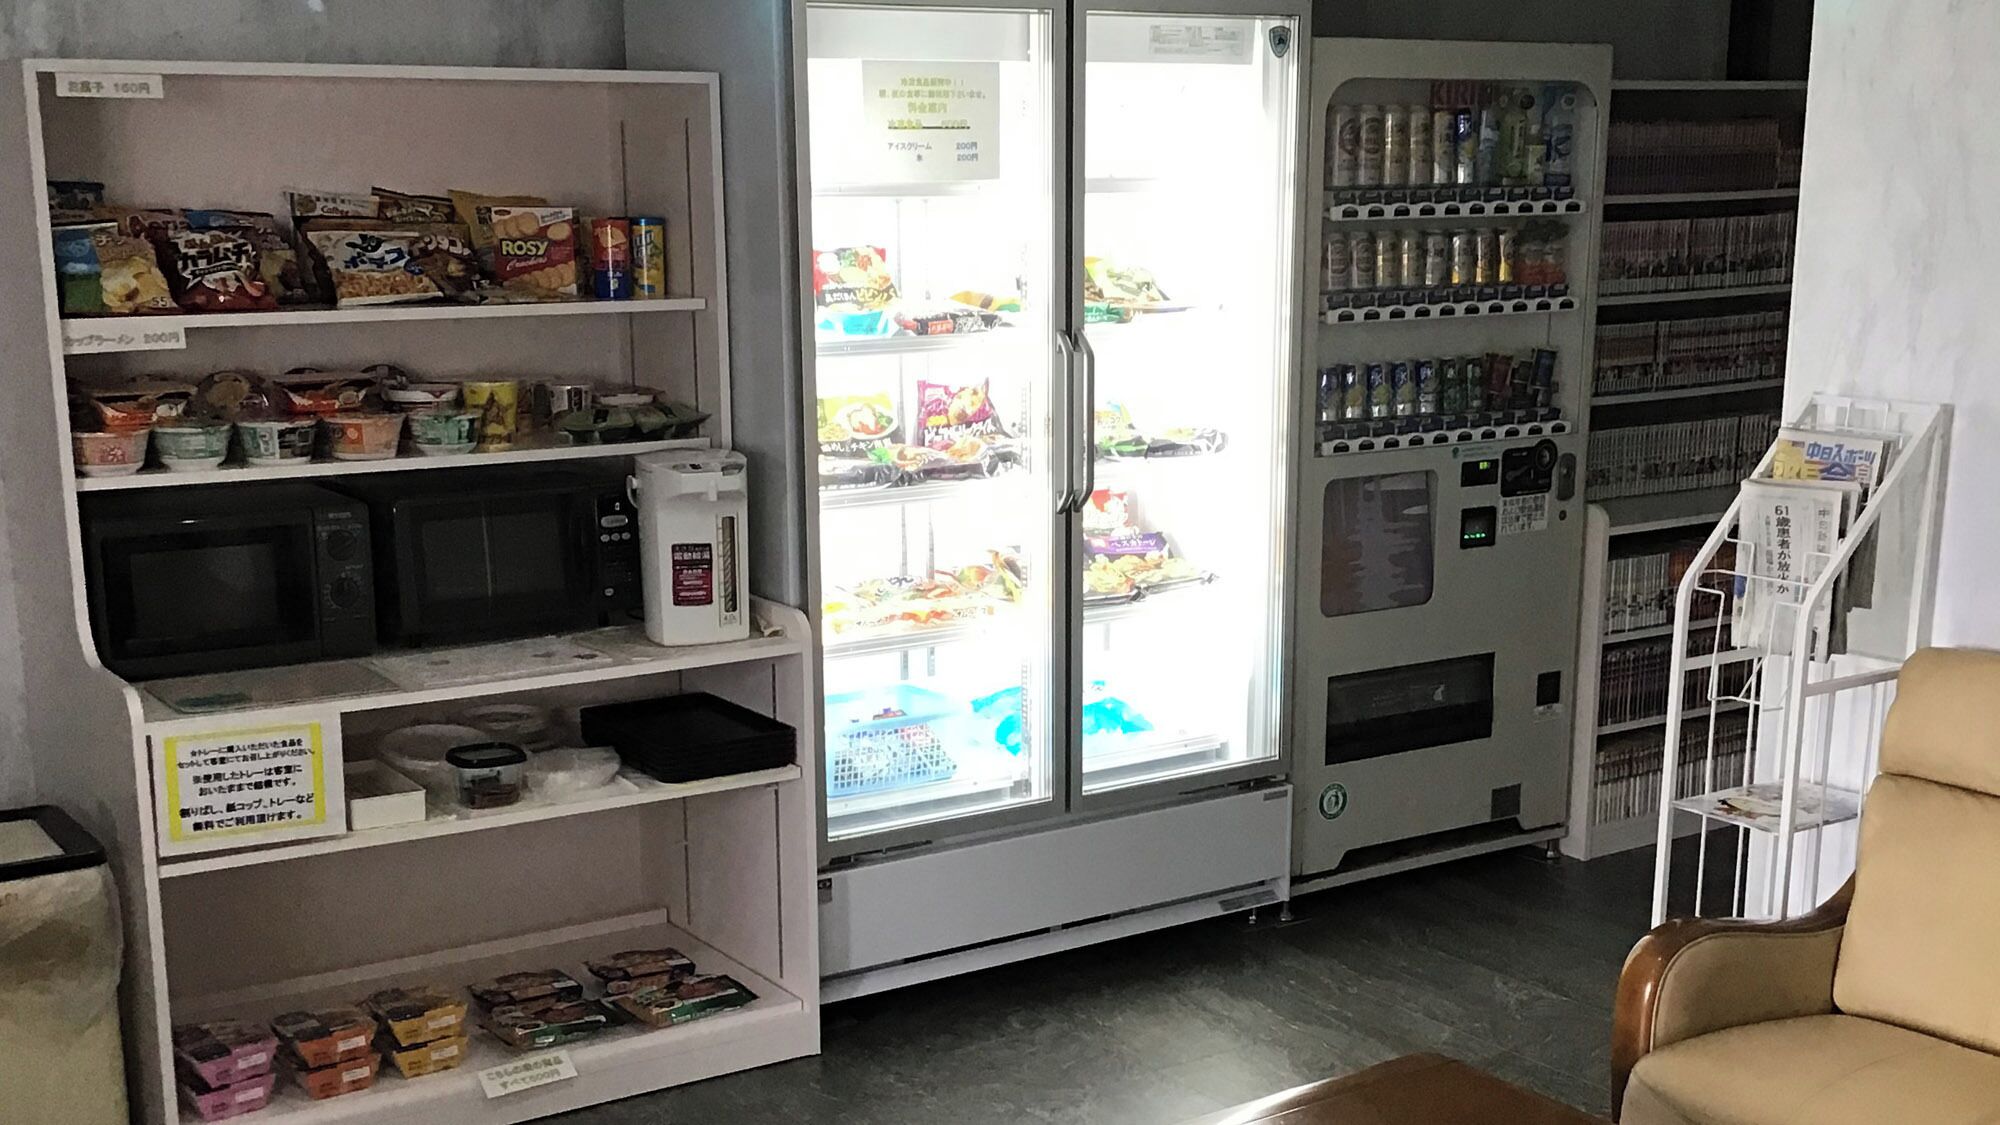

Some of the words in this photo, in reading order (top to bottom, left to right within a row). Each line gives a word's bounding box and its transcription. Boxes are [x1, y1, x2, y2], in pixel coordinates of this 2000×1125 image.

[888, 142, 932, 150] アイスクリーム
[956, 141, 978, 150] 200円
[956, 153, 979, 162] 200円
[320, 205, 350, 215] Calbee
[501, 239, 549, 257] ROSY
[1805, 440, 1878, 465] 中日スポーツ
